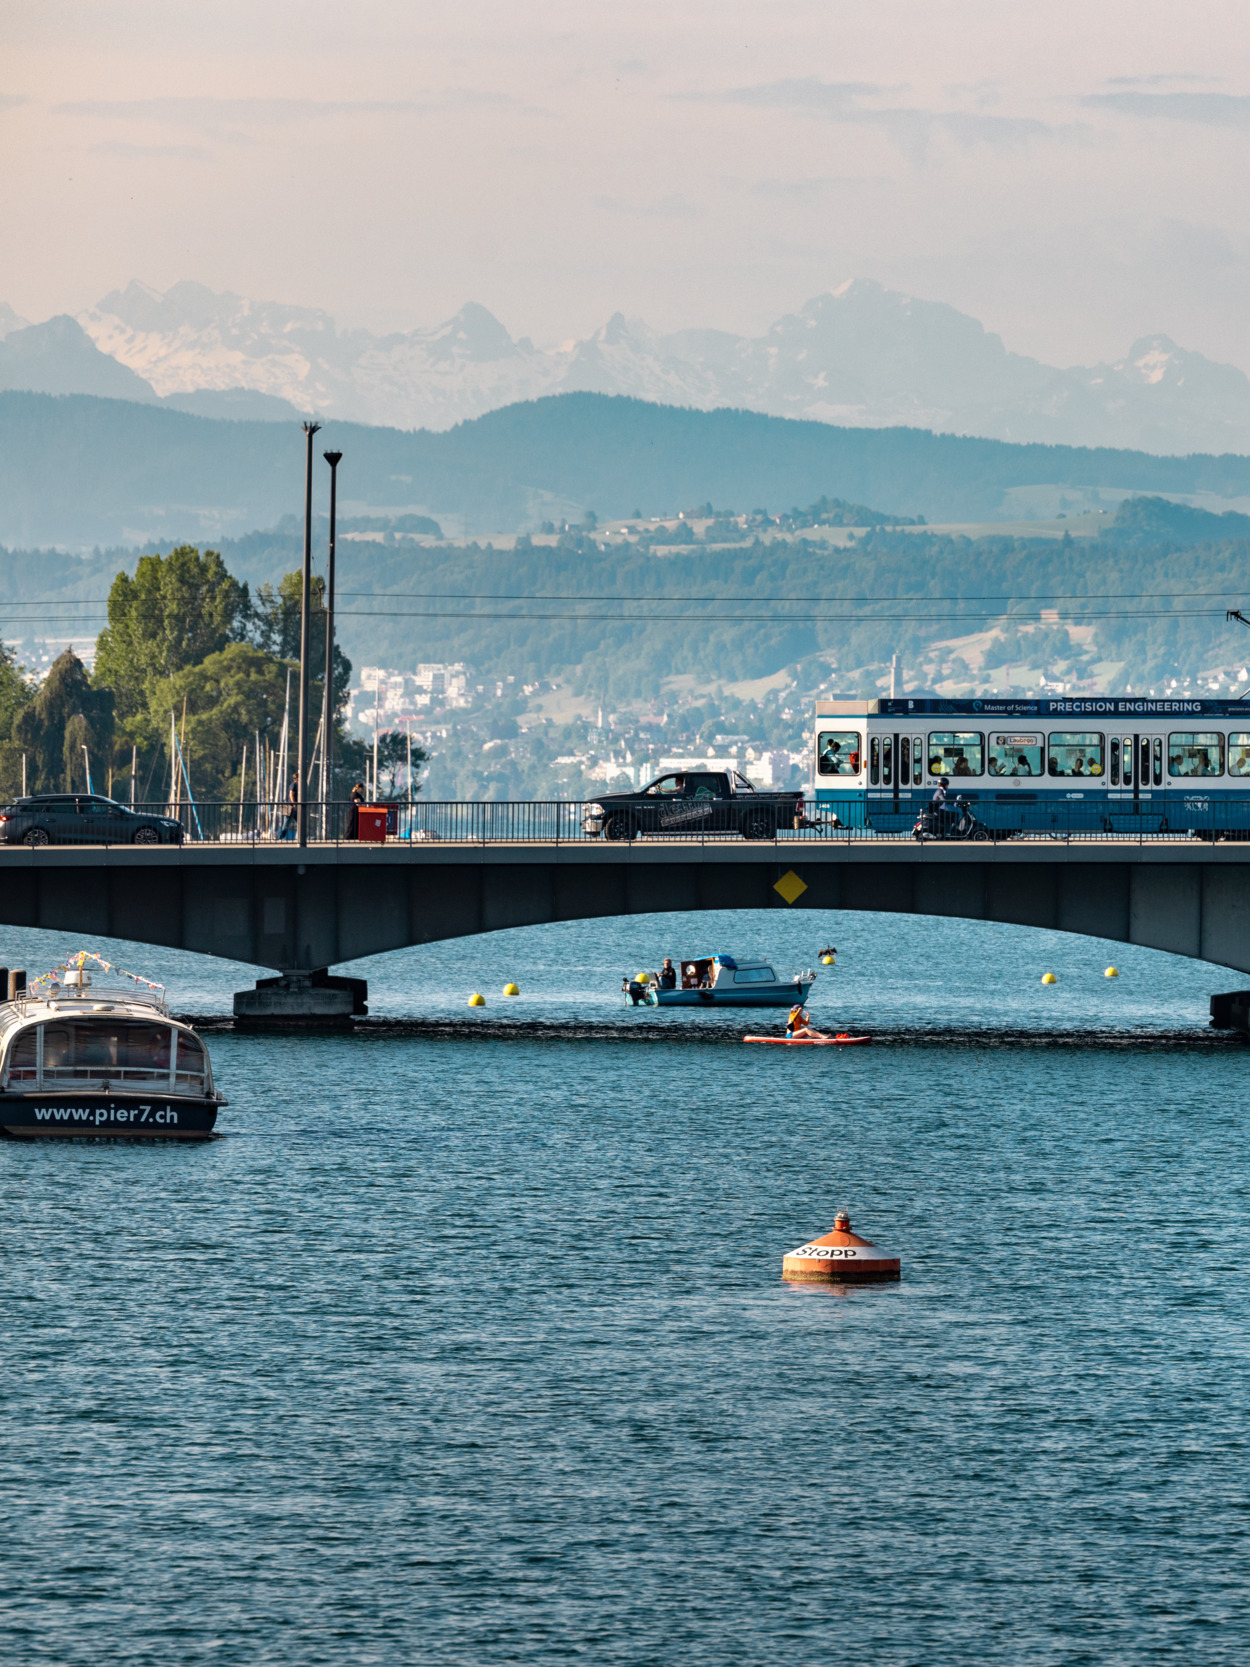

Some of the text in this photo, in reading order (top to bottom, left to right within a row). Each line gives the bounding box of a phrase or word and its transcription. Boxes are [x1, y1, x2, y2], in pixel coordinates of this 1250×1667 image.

[1050, 702, 1201, 711] PRECISION ENGINEERING
[34, 1103, 178, 1125] www.pier7.ch
[796, 1246, 857, 1259] Stopp
